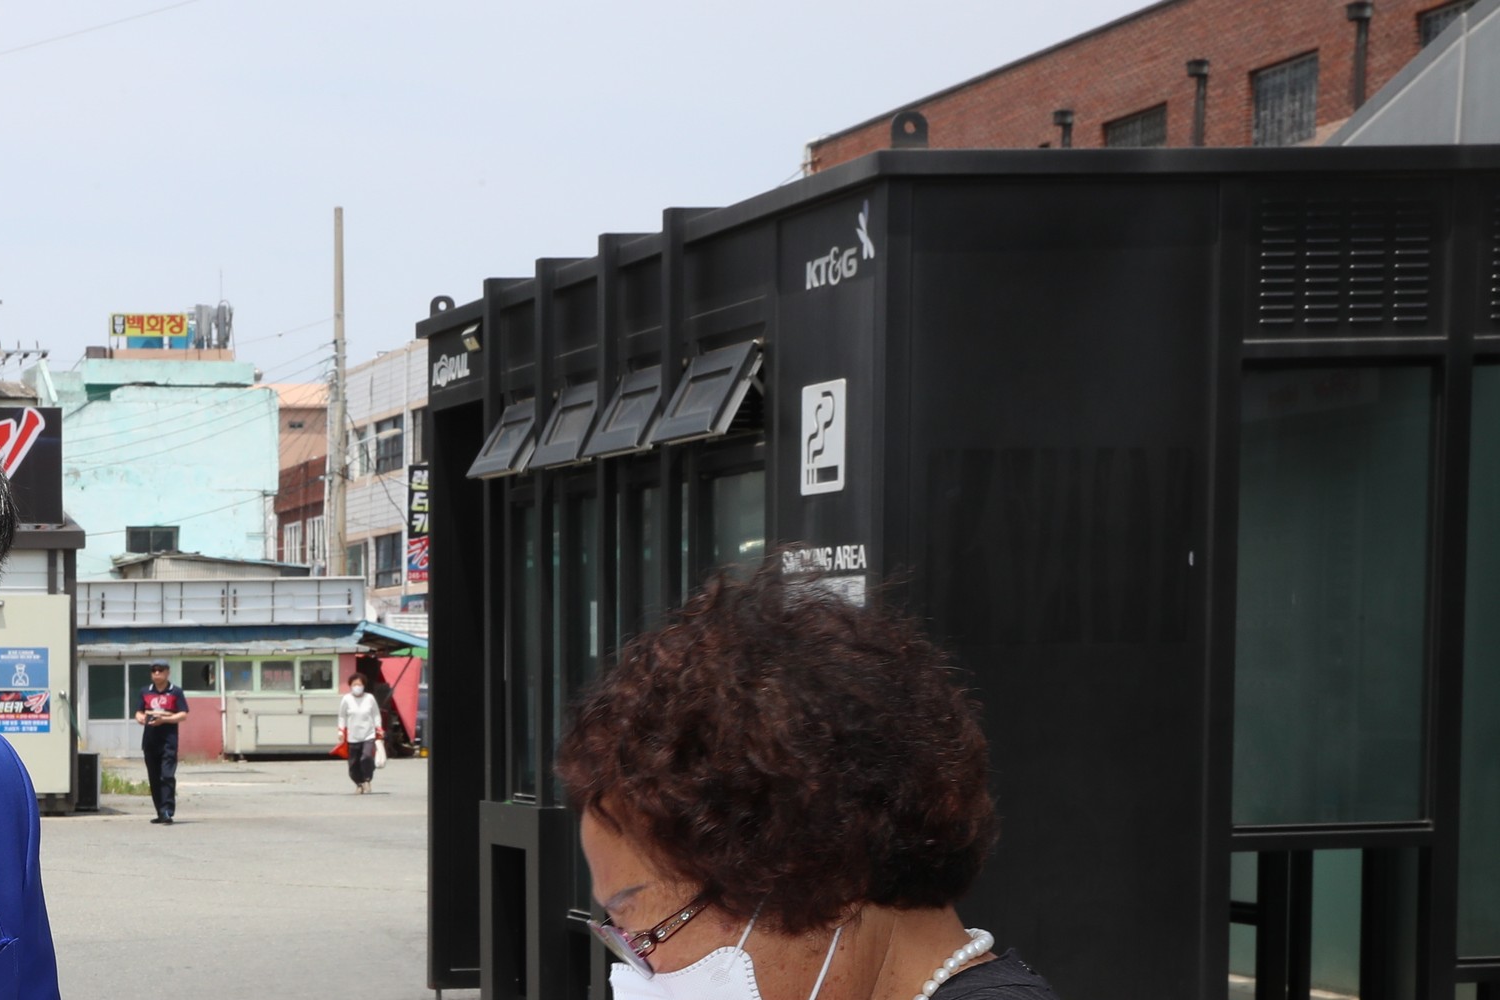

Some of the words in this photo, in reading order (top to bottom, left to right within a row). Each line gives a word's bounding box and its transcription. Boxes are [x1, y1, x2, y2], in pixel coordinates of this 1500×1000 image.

[806, 246, 858, 290] KT&G
[126, 314, 186, 335] 백화장
[432, 352, 470, 387] KORAIL
[834, 544, 866, 570] AREA
